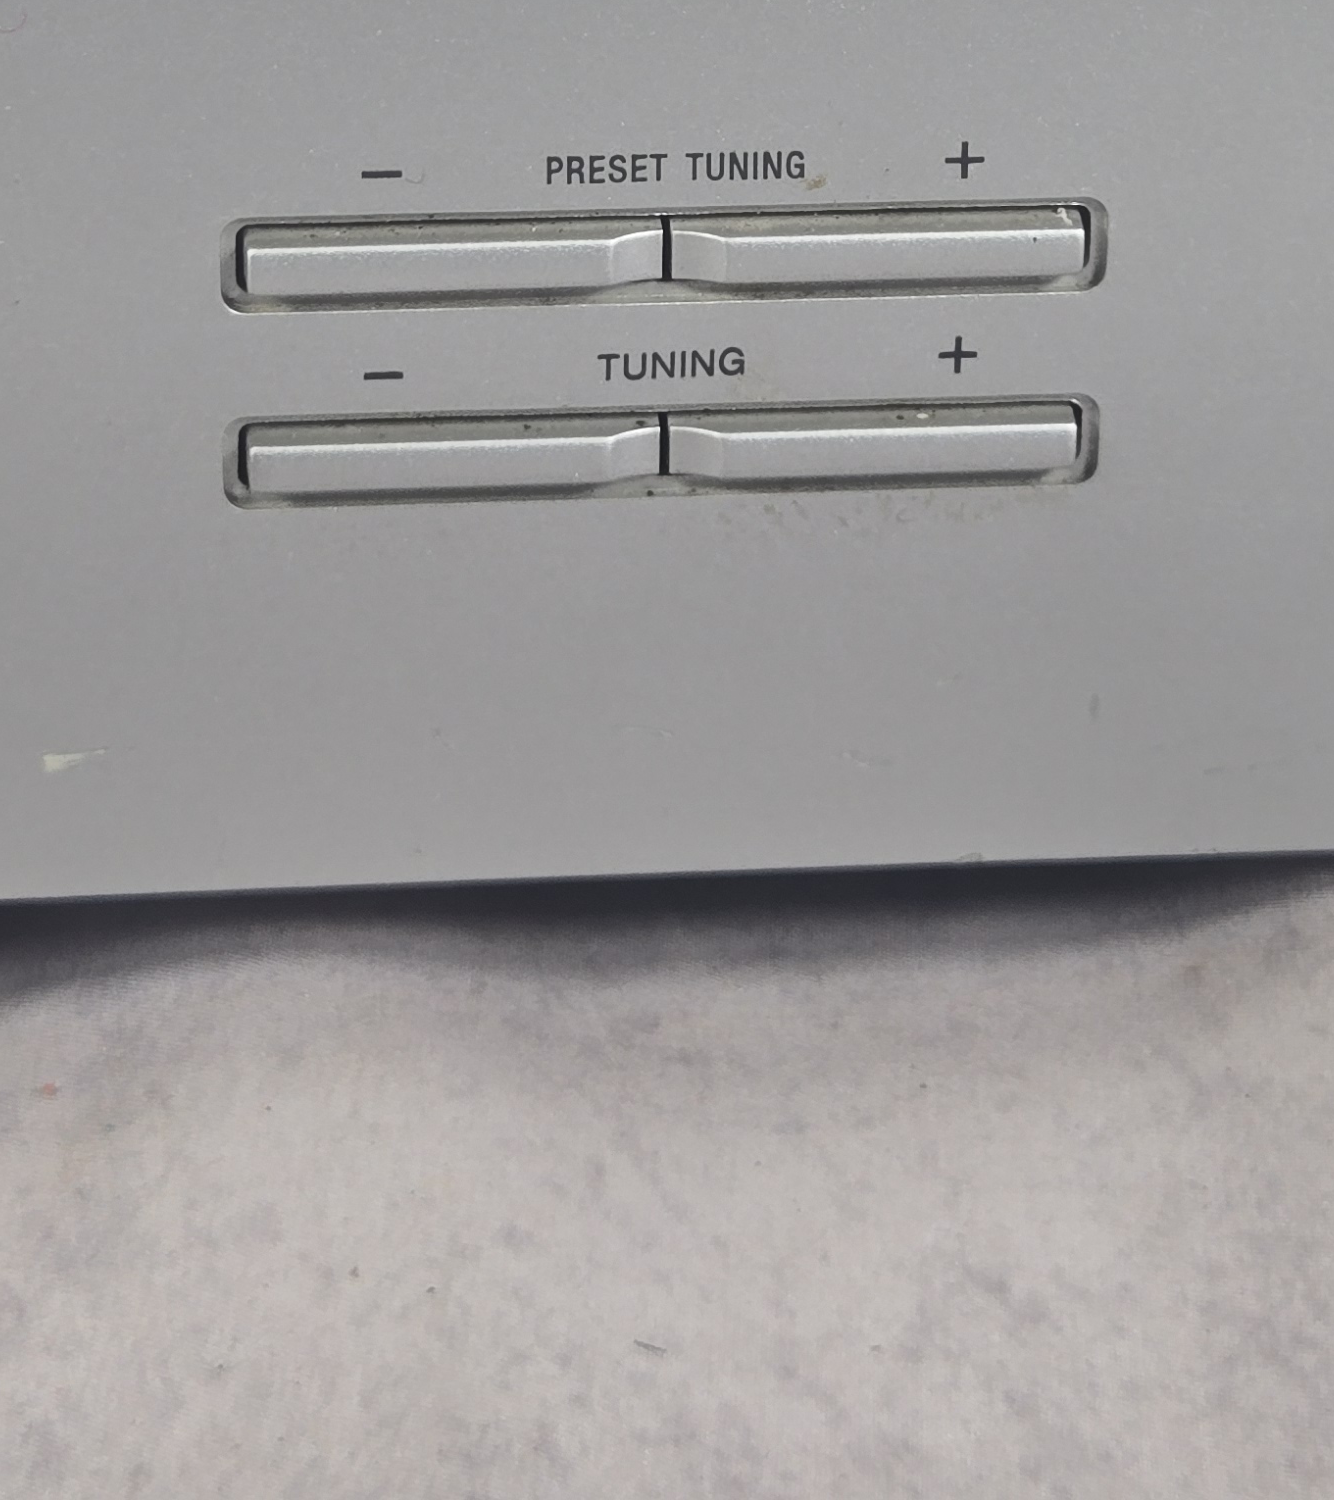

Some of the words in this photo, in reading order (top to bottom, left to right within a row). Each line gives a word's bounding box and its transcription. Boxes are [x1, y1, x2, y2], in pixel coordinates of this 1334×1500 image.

[545, 152, 669, 186] PRESET
[684, 149, 806, 183] TUNING
[595, 345, 747, 383] TUNING
